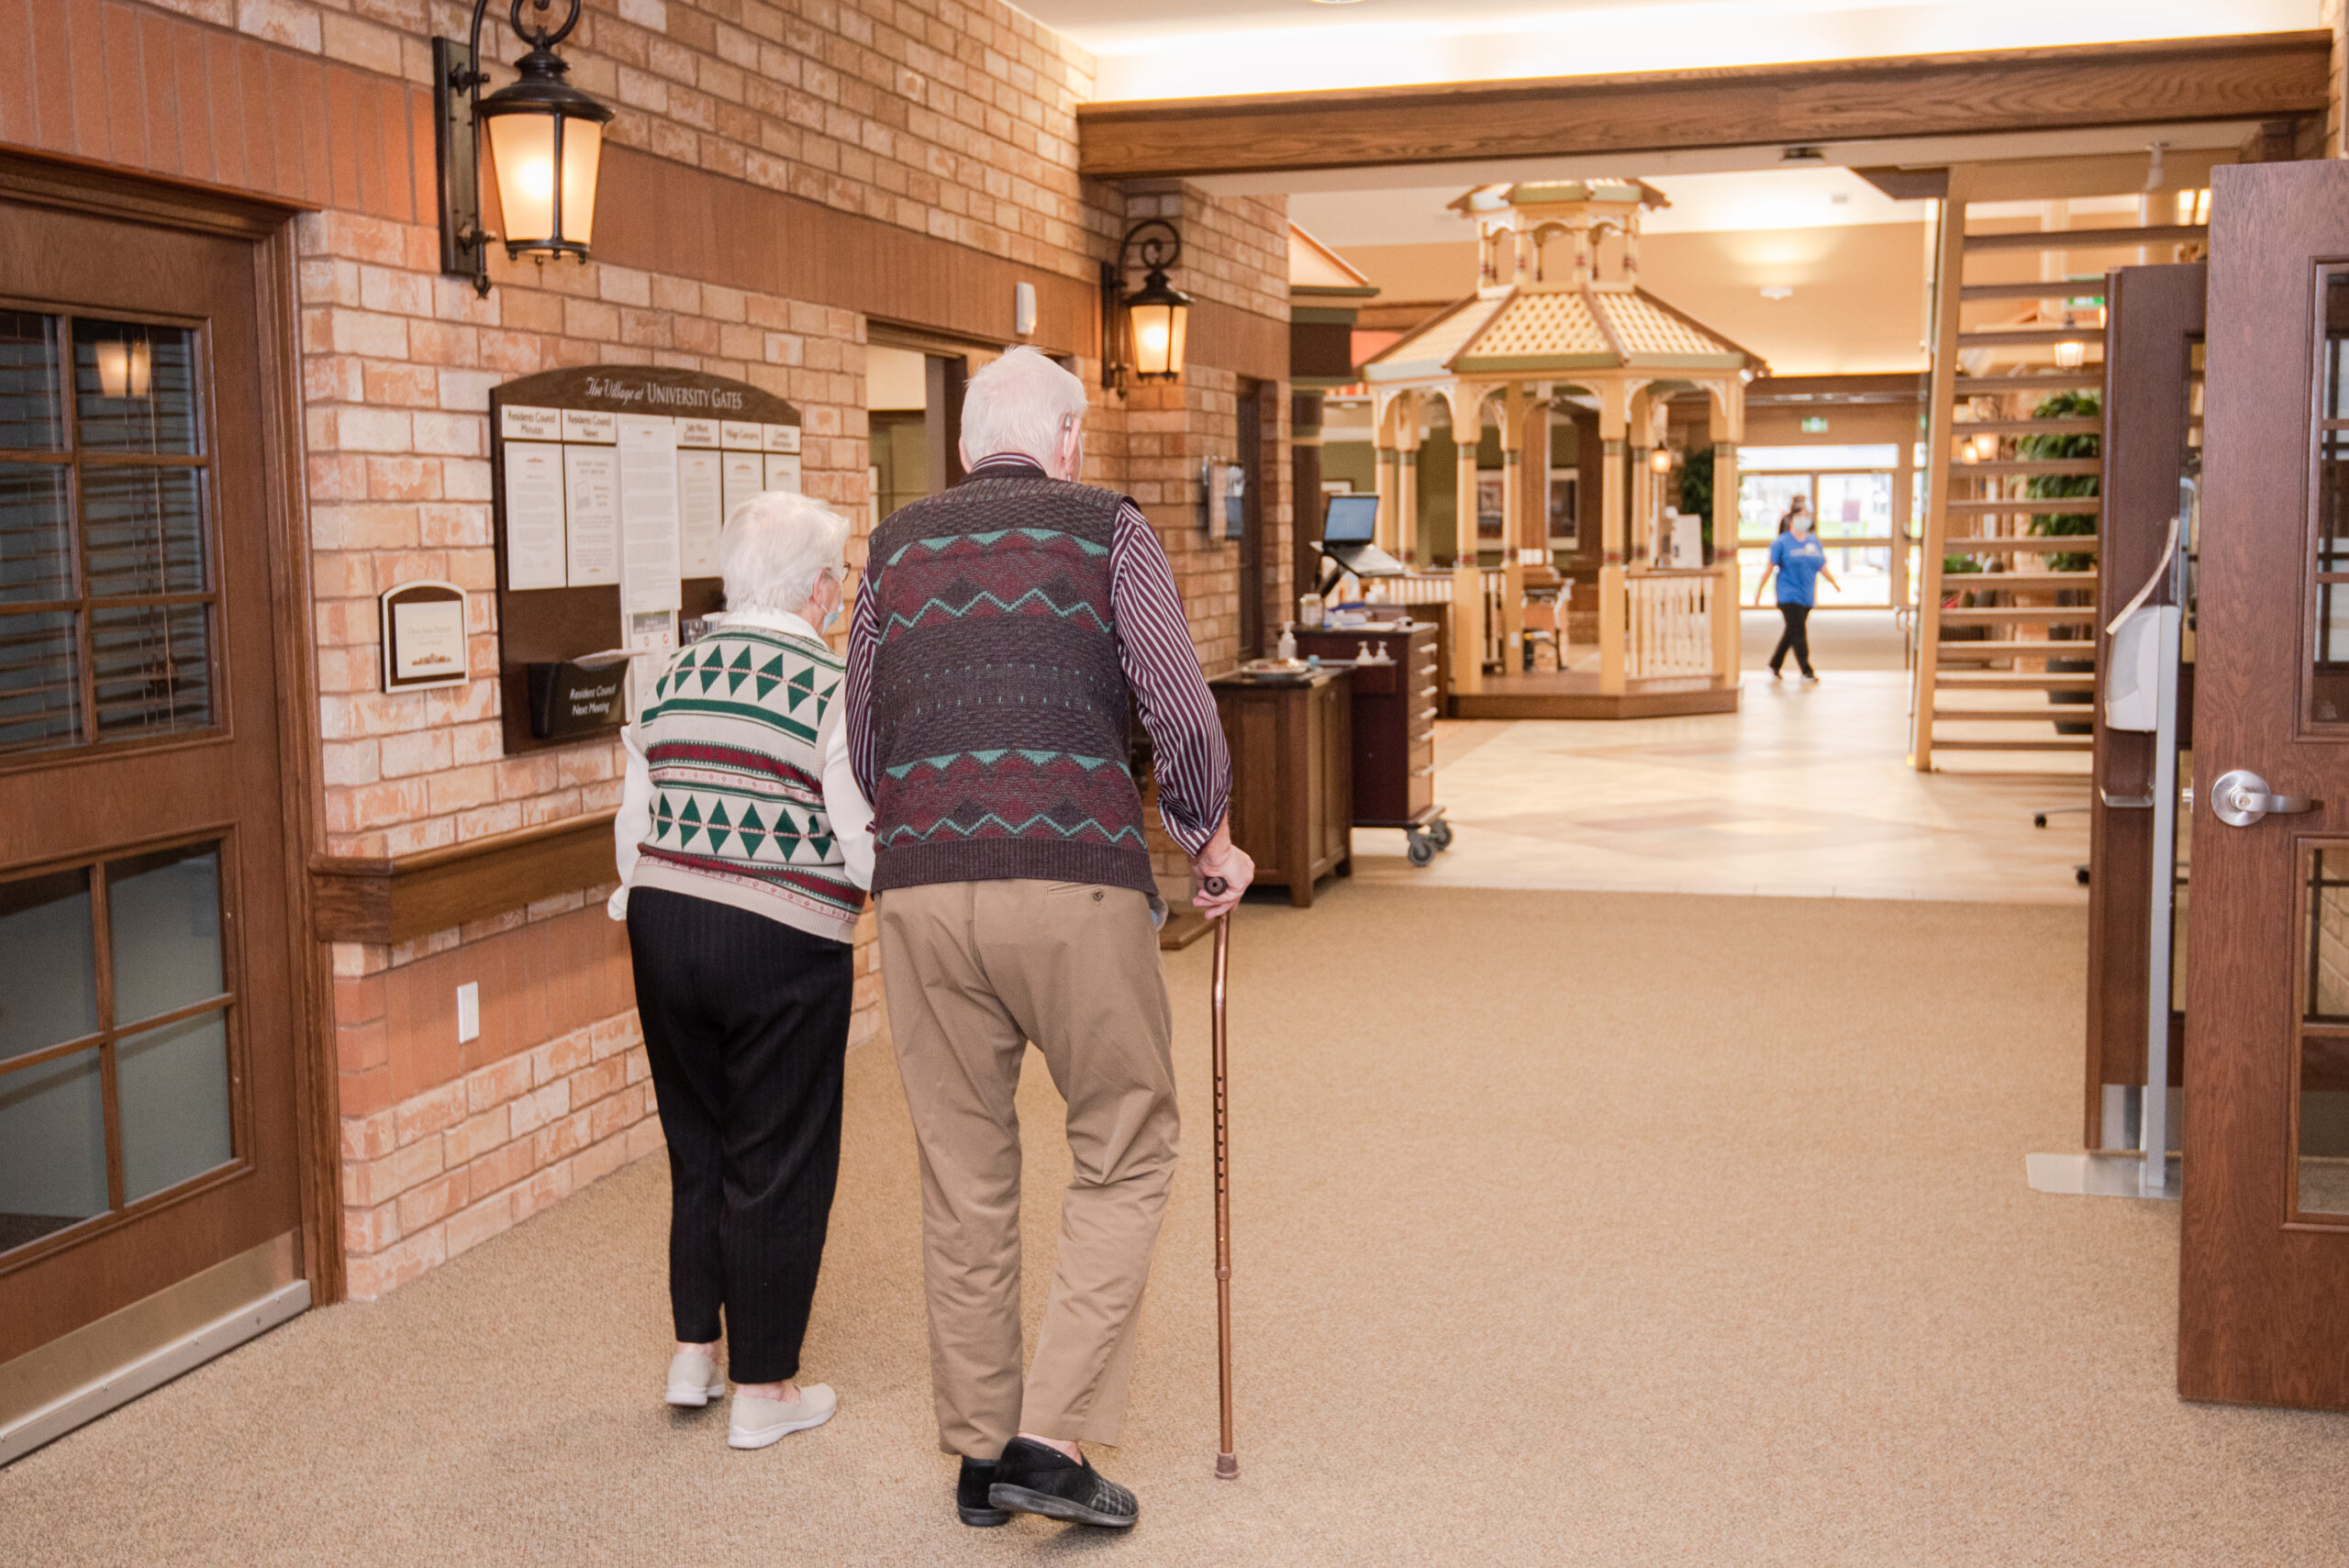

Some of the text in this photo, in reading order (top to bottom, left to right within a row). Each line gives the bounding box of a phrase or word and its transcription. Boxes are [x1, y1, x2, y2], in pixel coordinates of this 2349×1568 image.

[585, 377, 742, 409] The Village at UNIVERSITY GATES
[535, 410, 556, 423] Council
[593, 415, 612, 426] Council
[520, 424, 544, 435] Minutes
[584, 428, 598, 438] News
[596, 684, 617, 696] Council
[573, 702, 609, 716] Next Meeting
